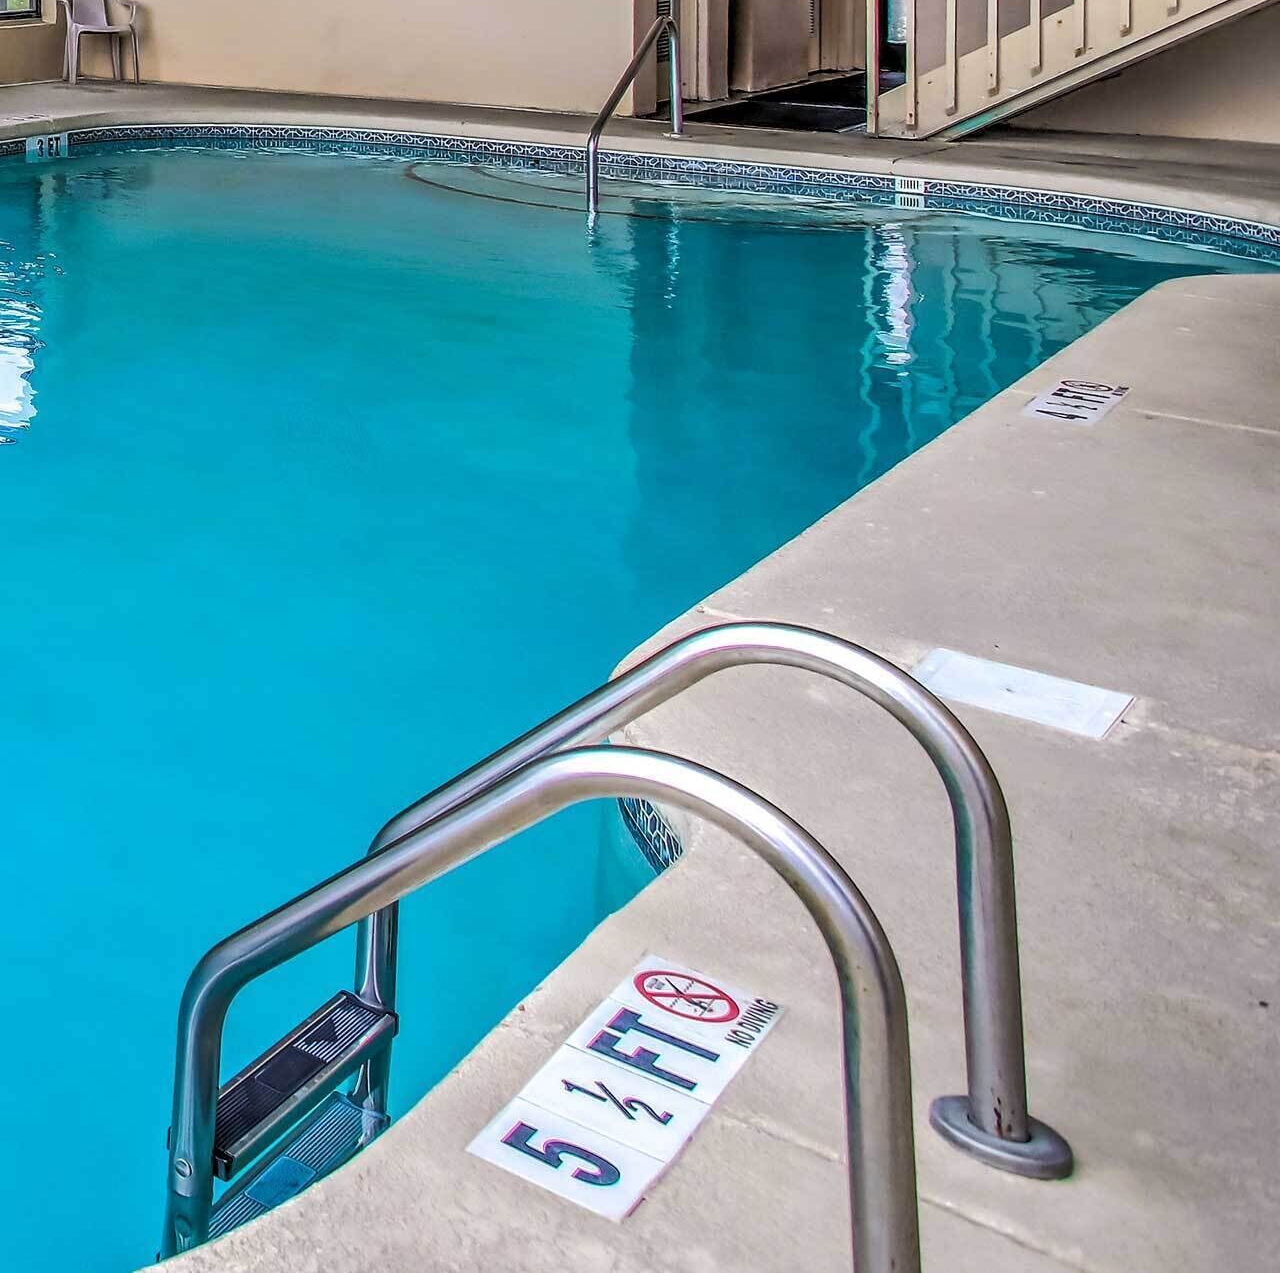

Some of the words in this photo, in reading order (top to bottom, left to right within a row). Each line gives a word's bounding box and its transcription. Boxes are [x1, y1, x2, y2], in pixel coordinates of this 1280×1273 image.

[1051, 387, 1111, 404] FT
[738, 998, 779, 1034] DIVING
[724, 1029, 756, 1049] NO
[501, 1121, 620, 1186] 5
[587, 1006, 721, 1092] FT
